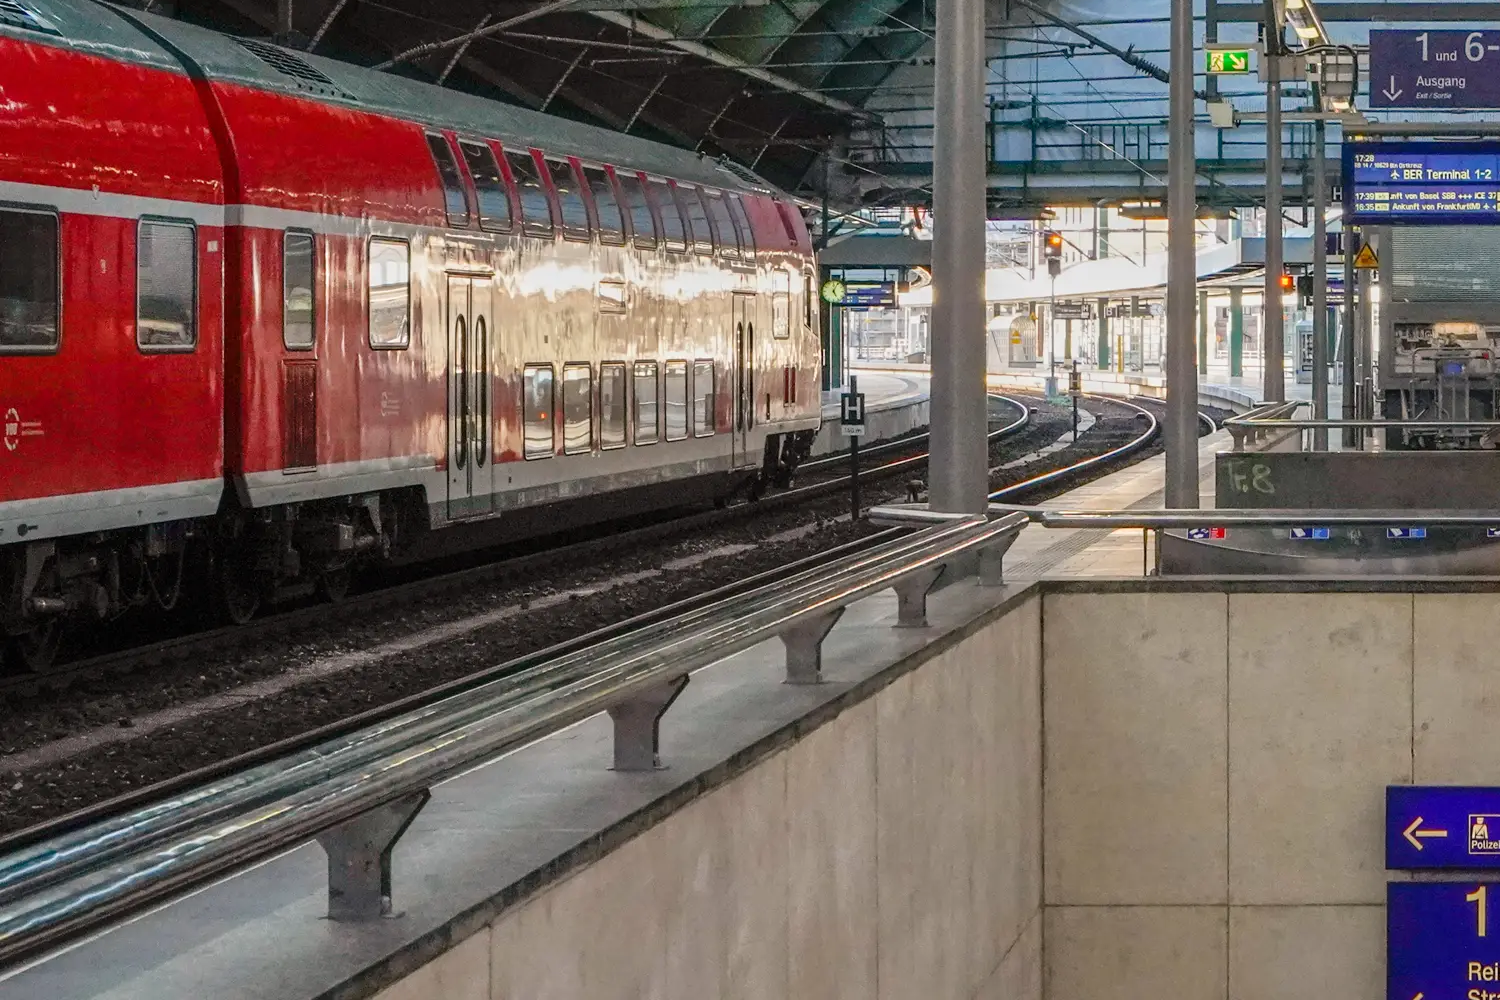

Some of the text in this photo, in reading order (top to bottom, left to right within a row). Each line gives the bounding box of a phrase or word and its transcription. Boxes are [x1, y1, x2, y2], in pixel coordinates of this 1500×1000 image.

[1415, 32, 1429, 62] 1
[1435, 51, 1457, 62] und
[1416, 75, 1466, 89] Ausgang
[1354, 154, 1375, 162] 17:28
[1403, 169, 1492, 180] BER Terminal 1-2
[1354, 192, 1375, 201] 17:39
[1419, 192, 1440, 200] Basel
[1441, 192, 1456, 200] SBB
[1474, 192, 1486, 200] ICE
[1392, 202, 1420, 211] Ankunft
[1421, 203, 1435, 211] von
[844, 396, 861, 420] H
[1471, 839, 1500, 849] Polizei
[1465, 885, 1488, 937] 1
